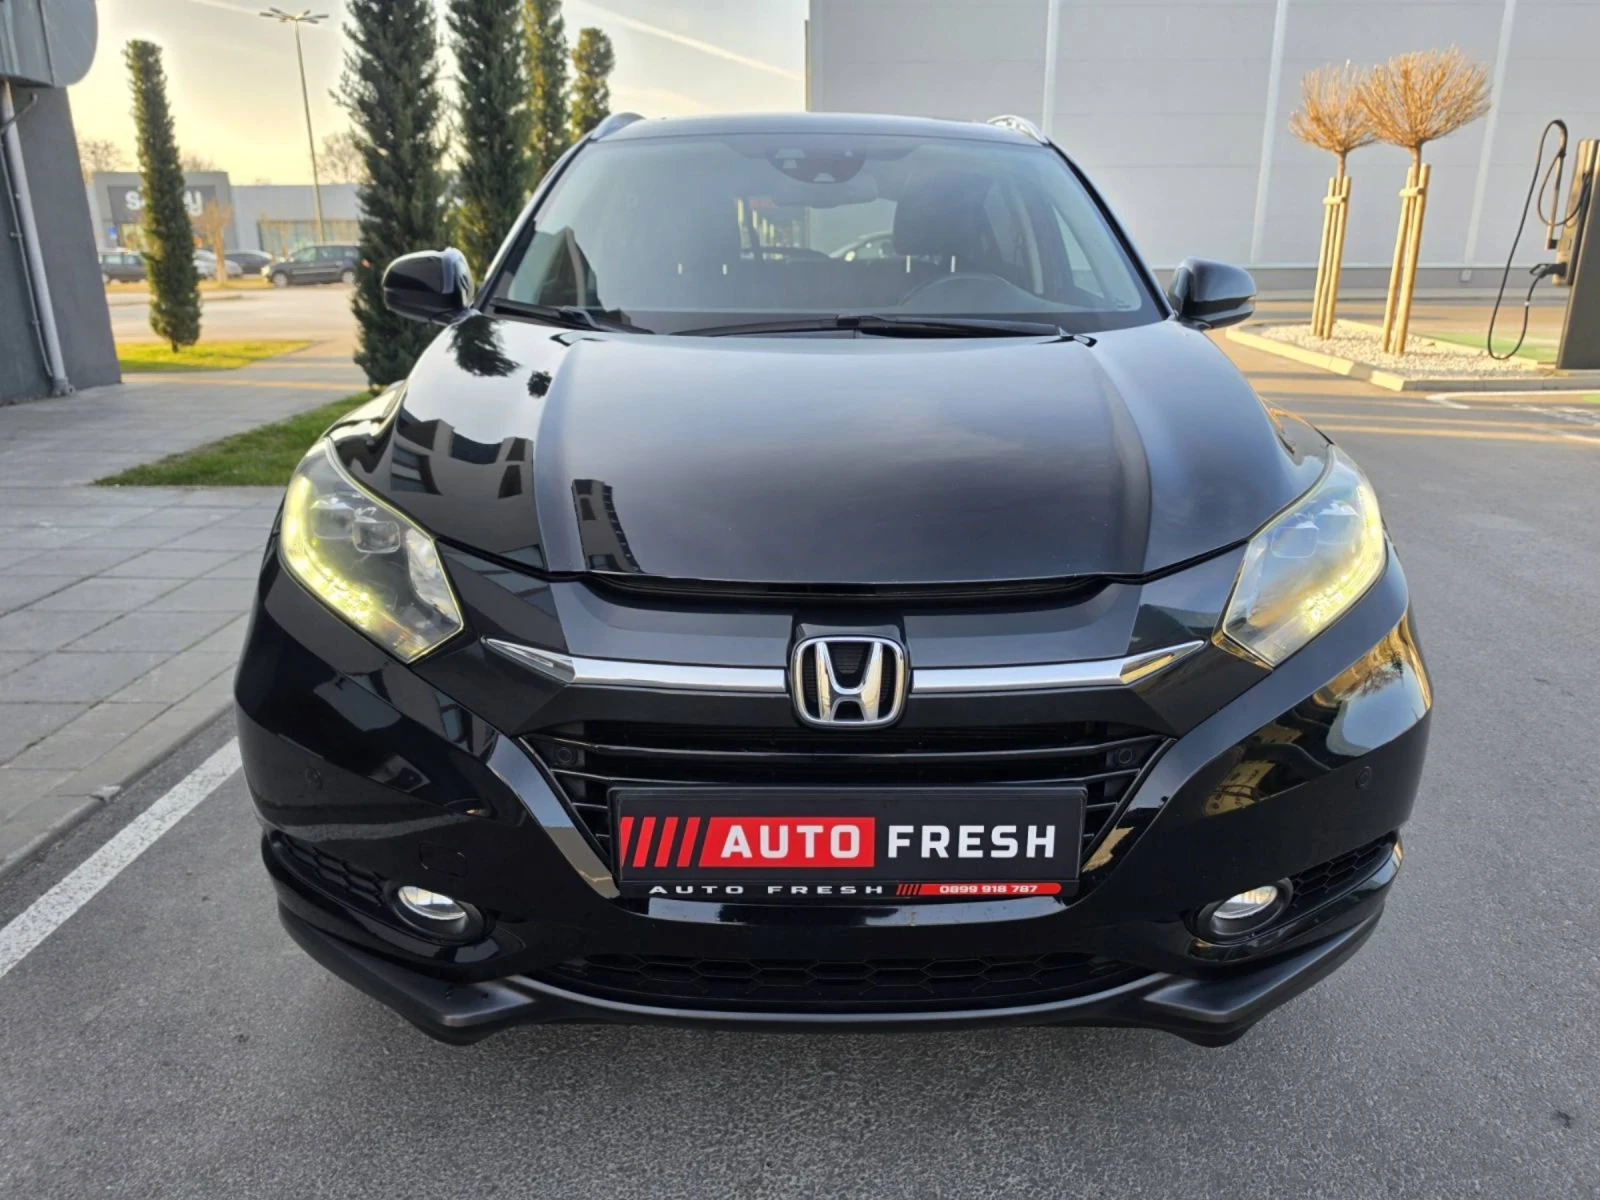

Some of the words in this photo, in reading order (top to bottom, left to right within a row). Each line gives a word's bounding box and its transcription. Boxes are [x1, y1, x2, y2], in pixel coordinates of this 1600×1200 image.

[720, 824, 861, 859] AUTO
[887, 825, 1056, 858] FRESH
[648, 885, 744, 895] AUTO
[767, 885, 883, 895] FRESH
[939, 885, 978, 894] 0899
[981, 885, 1007, 894] 918
[1011, 885, 1038, 894] 787
